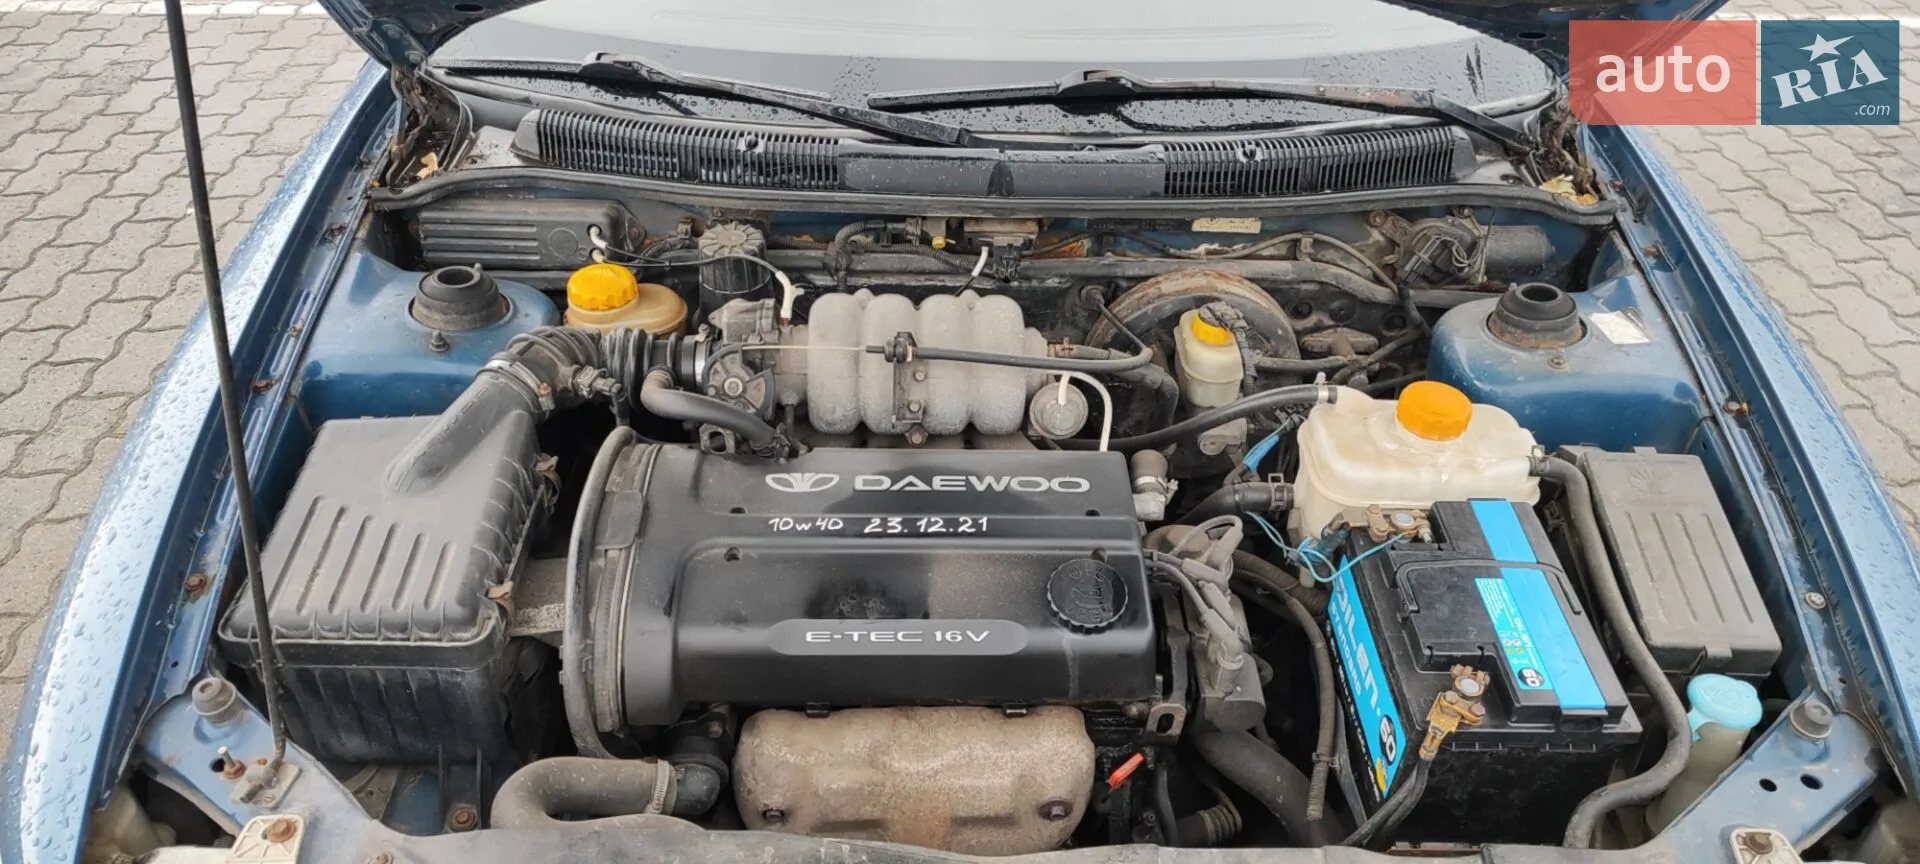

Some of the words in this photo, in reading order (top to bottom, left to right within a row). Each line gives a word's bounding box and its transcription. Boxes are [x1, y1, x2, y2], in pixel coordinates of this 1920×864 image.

[854, 475, 1091, 493] DAEWOO
[863, 516, 989, 534] 23.12.21
[806, 631, 923, 643] E-TEC
[934, 630, 990, 643] 16V
